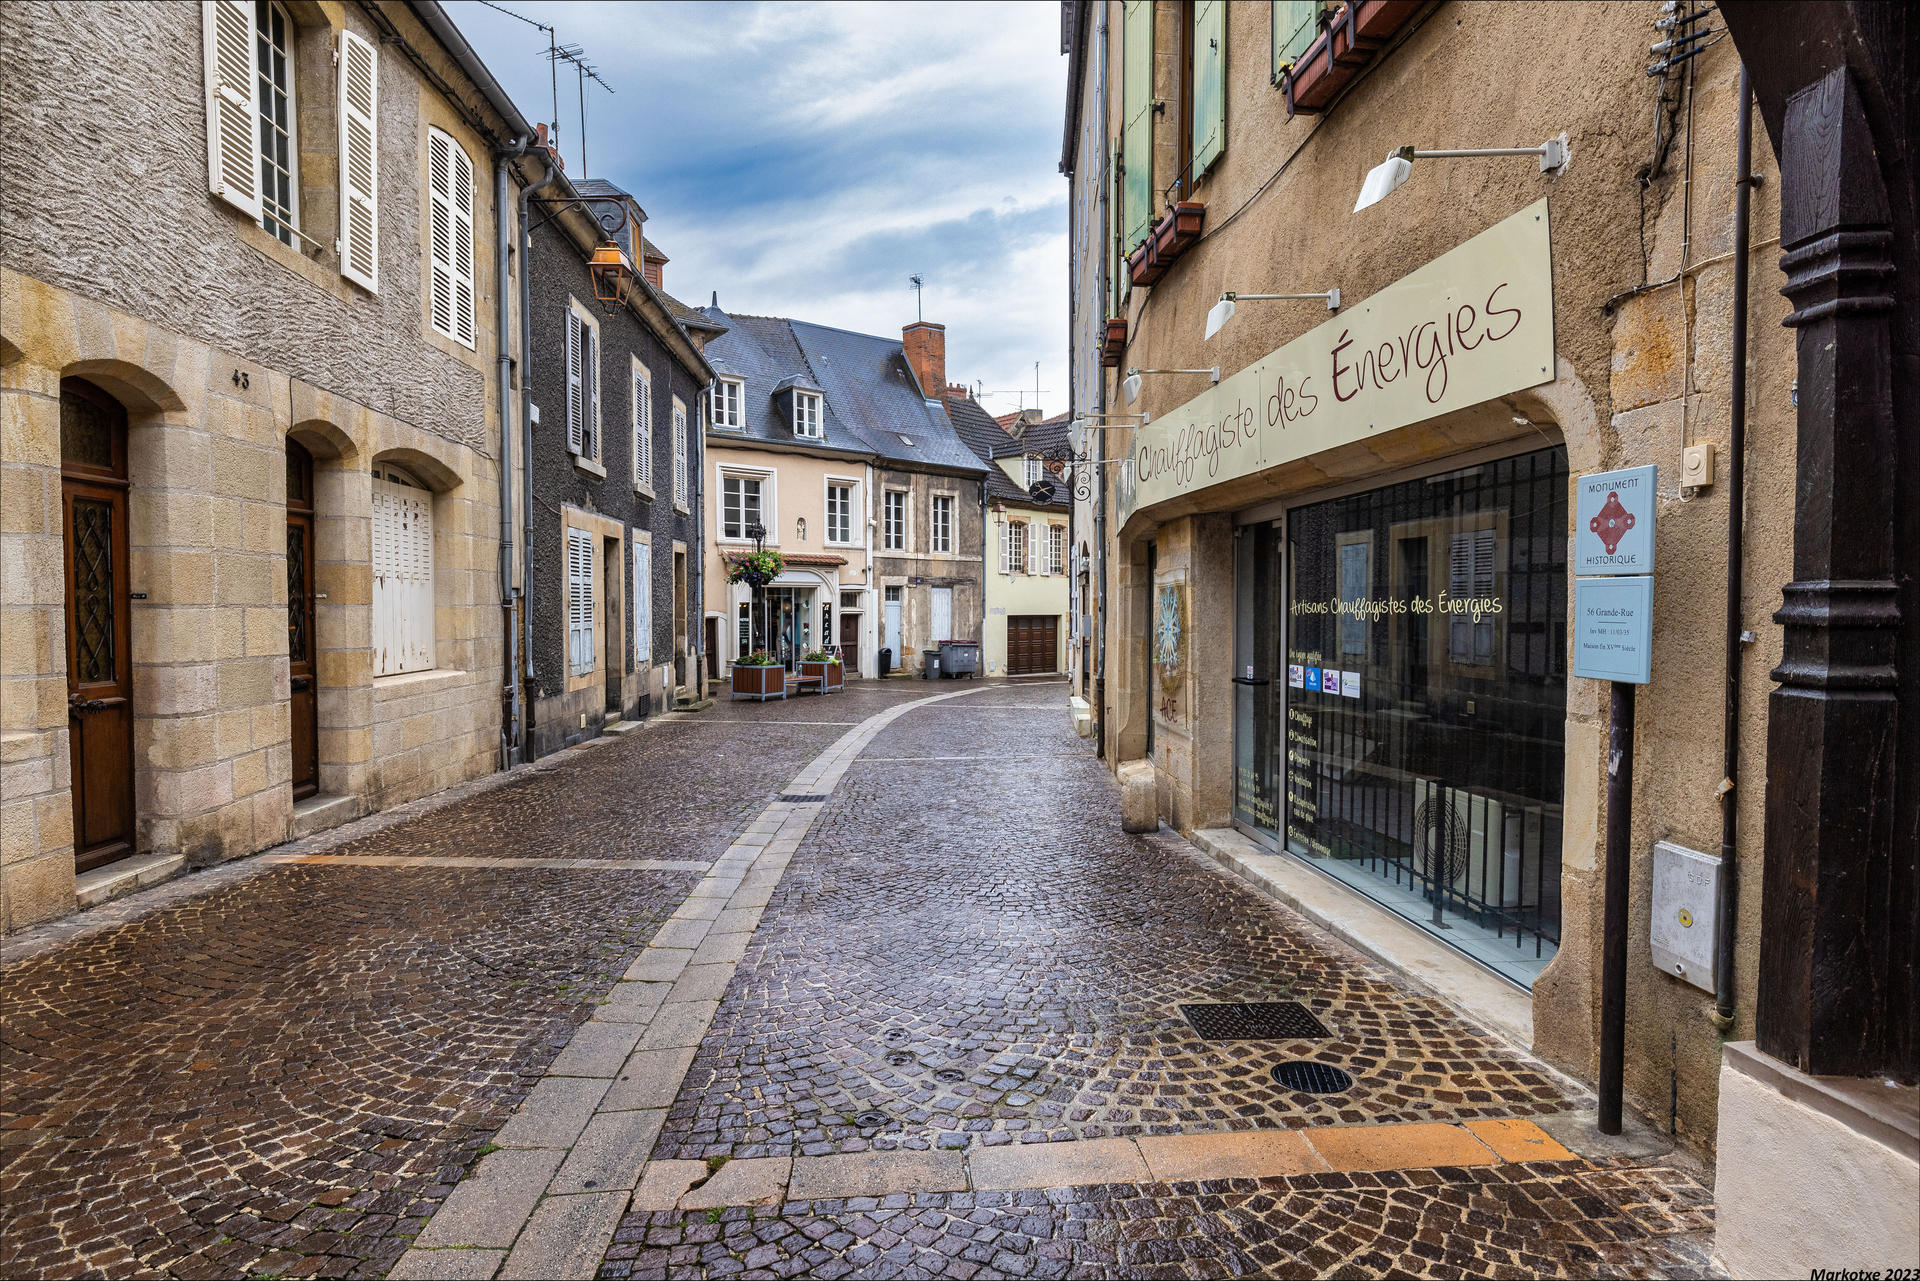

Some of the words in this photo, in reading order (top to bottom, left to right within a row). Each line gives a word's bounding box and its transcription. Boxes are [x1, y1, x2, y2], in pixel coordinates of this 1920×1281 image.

[232, 369, 249, 389] 43
[1138, 398, 1257, 486] Chauffagiste
[1267, 376, 1318, 430] des
[1330, 283, 1522, 404] Énergies
[1588, 477, 1640, 493] MONUMENT
[1586, 554, 1637, 565] HISTORIQUE
[1290, 599, 1328, 616] Artisans
[1331, 595, 1407, 622] Chauffagistes
[1411, 595, 1434, 614] des
[1438, 589, 1503, 624] Énergies
[1587, 607, 1595, 616] 56
[1596, 607, 1634, 617] Grande-Rue
[1160, 696, 1177, 723] ACE
